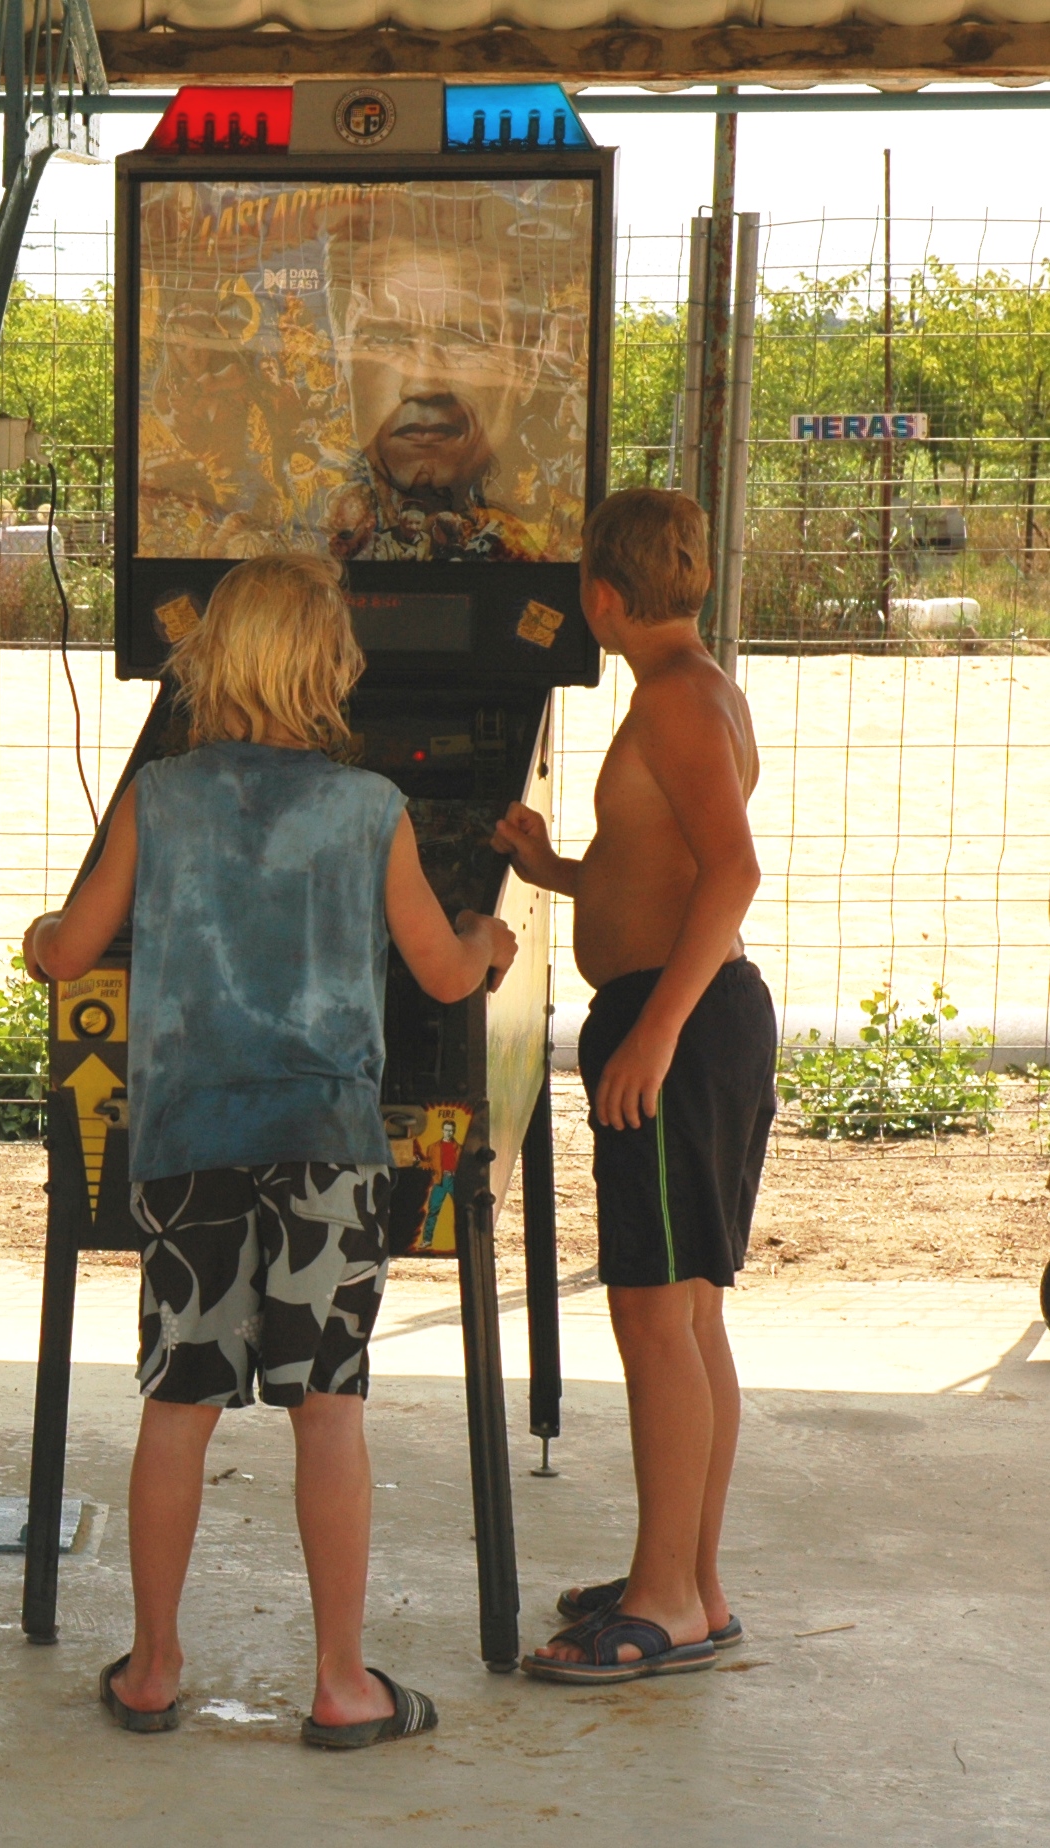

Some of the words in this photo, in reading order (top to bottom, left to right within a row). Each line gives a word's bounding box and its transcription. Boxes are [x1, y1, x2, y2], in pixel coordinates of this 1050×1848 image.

[198, 197, 269, 244] LAST
[289, 268, 319, 279] DATA
[289, 279, 320, 290] EAST
[797, 415, 914, 439] HERAS
[437, 1109, 456, 1119] FIRE
